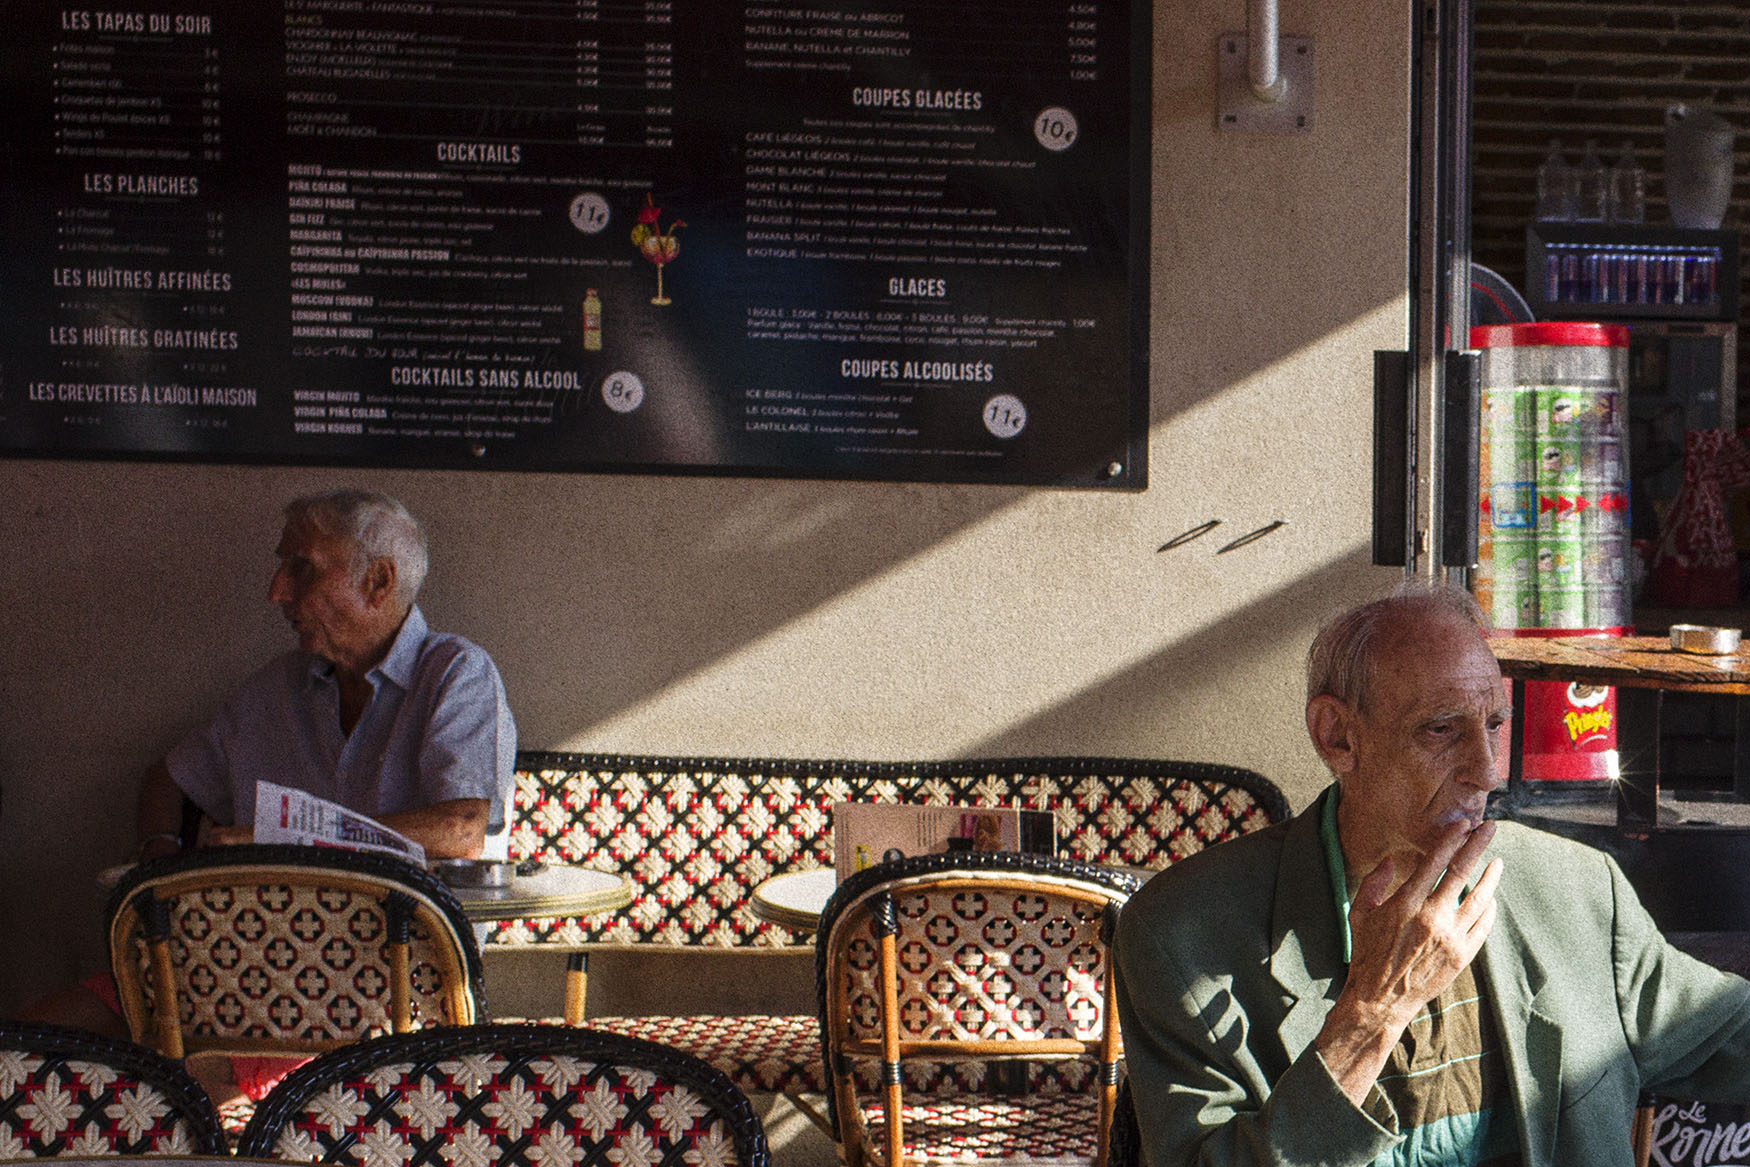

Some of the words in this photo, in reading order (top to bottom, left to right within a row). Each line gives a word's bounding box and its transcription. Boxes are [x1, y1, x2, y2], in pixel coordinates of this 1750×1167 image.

[61, 10, 91, 31] LES
[95, 11, 145, 33] TAPAS
[148, 13, 171, 33] DU
[174, 14, 212, 35] SOIR
[745, 25, 793, 36] NUTELLA
[853, 86, 911, 108] COUPES
[915, 87, 983, 111] GLACÉES
[437, 142, 521, 164] COCKTAILS
[83, 173, 113, 194] LES
[117, 173, 200, 196] PLANCHES
[53, 266, 82, 287] LES
[87, 266, 153, 289] HUÎTRES
[157, 269, 232, 292] AFFINÉES
[888, 276, 947, 298] GLACES
[50, 326, 78, 346] LES
[83, 325, 149, 348] HUÎTRES
[153, 329, 239, 351] GRATINÉES
[390, 365, 475, 388] COCKTAILS
[478, 368, 520, 389] SANS
[523, 370, 582, 391] ALCOOL
[841, 358, 899, 379] COUPES
[903, 359, 994, 382] ALCOOLISÉS
[29, 382, 55, 402] LES
[58, 383, 138, 404] CREVETTES
[202, 386, 258, 407] MAISON
[1678, 1100, 1707, 1124] Le
